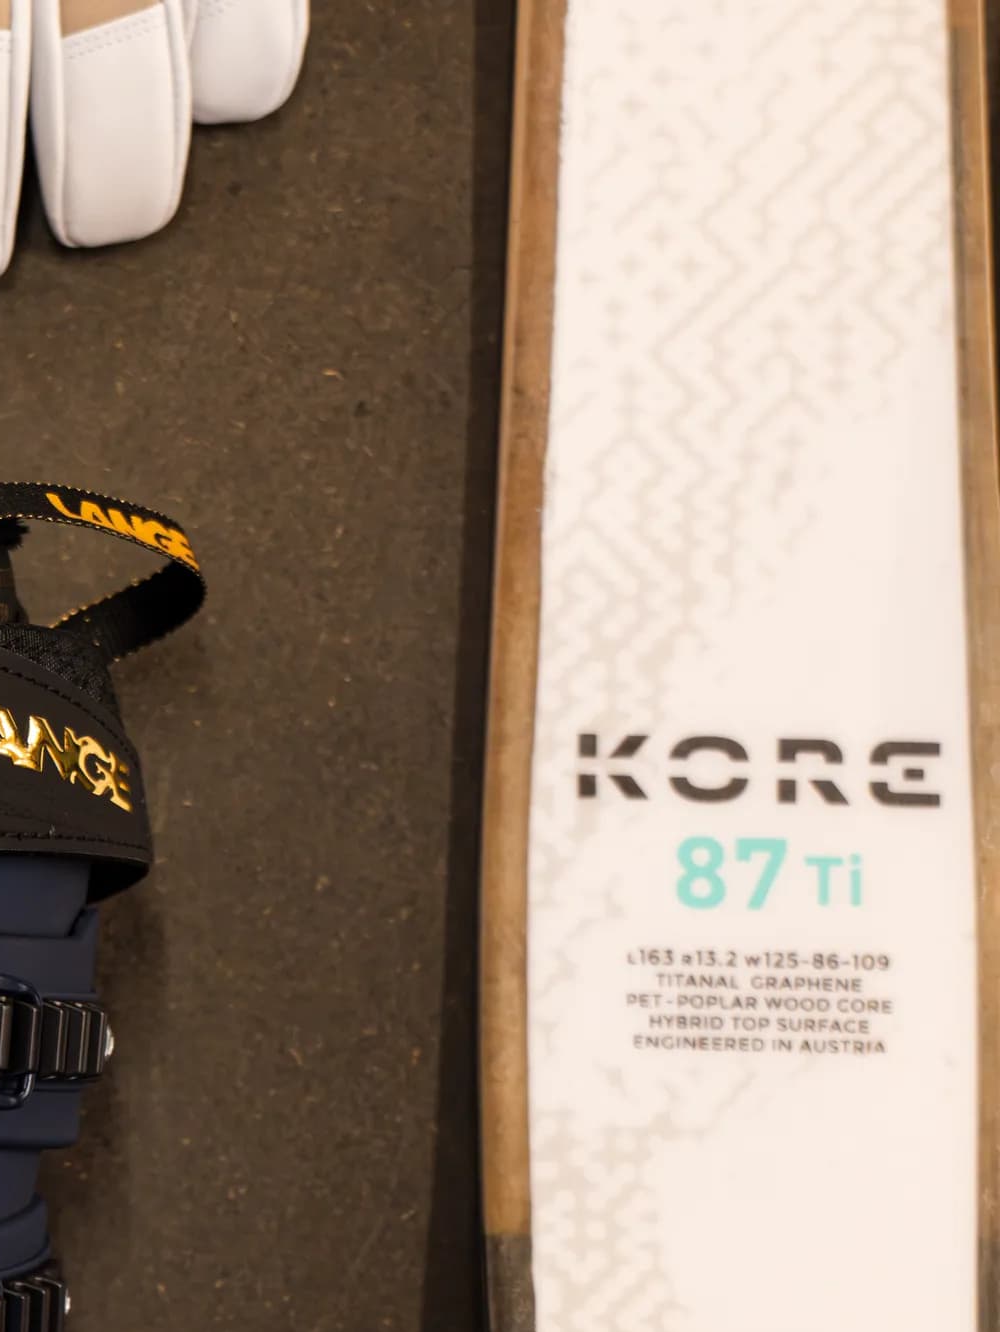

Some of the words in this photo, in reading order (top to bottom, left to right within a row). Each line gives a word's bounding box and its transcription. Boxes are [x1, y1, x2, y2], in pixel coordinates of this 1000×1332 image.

[45, 493, 200, 572] LANGE
[577, 733, 942, 808] KORE
[676, 836, 788, 910] 87
[804, 853, 863, 906] Ti
[657, 973, 738, 989] TITANAL
[750, 976, 863, 993] GRAPHENE
[764, 997, 830, 1012] WOOD
[837, 999, 893, 1014] CORE
[649, 1015, 723, 1030] HYBRID
[733, 1017, 770, 1031] TOP
[777, 1018, 870, 1034] SURFACE
[633, 1035, 764, 1052] ENGINEERED
[772, 1039, 792, 1052] IN
[800, 1040, 886, 1055] AUSTRIA
